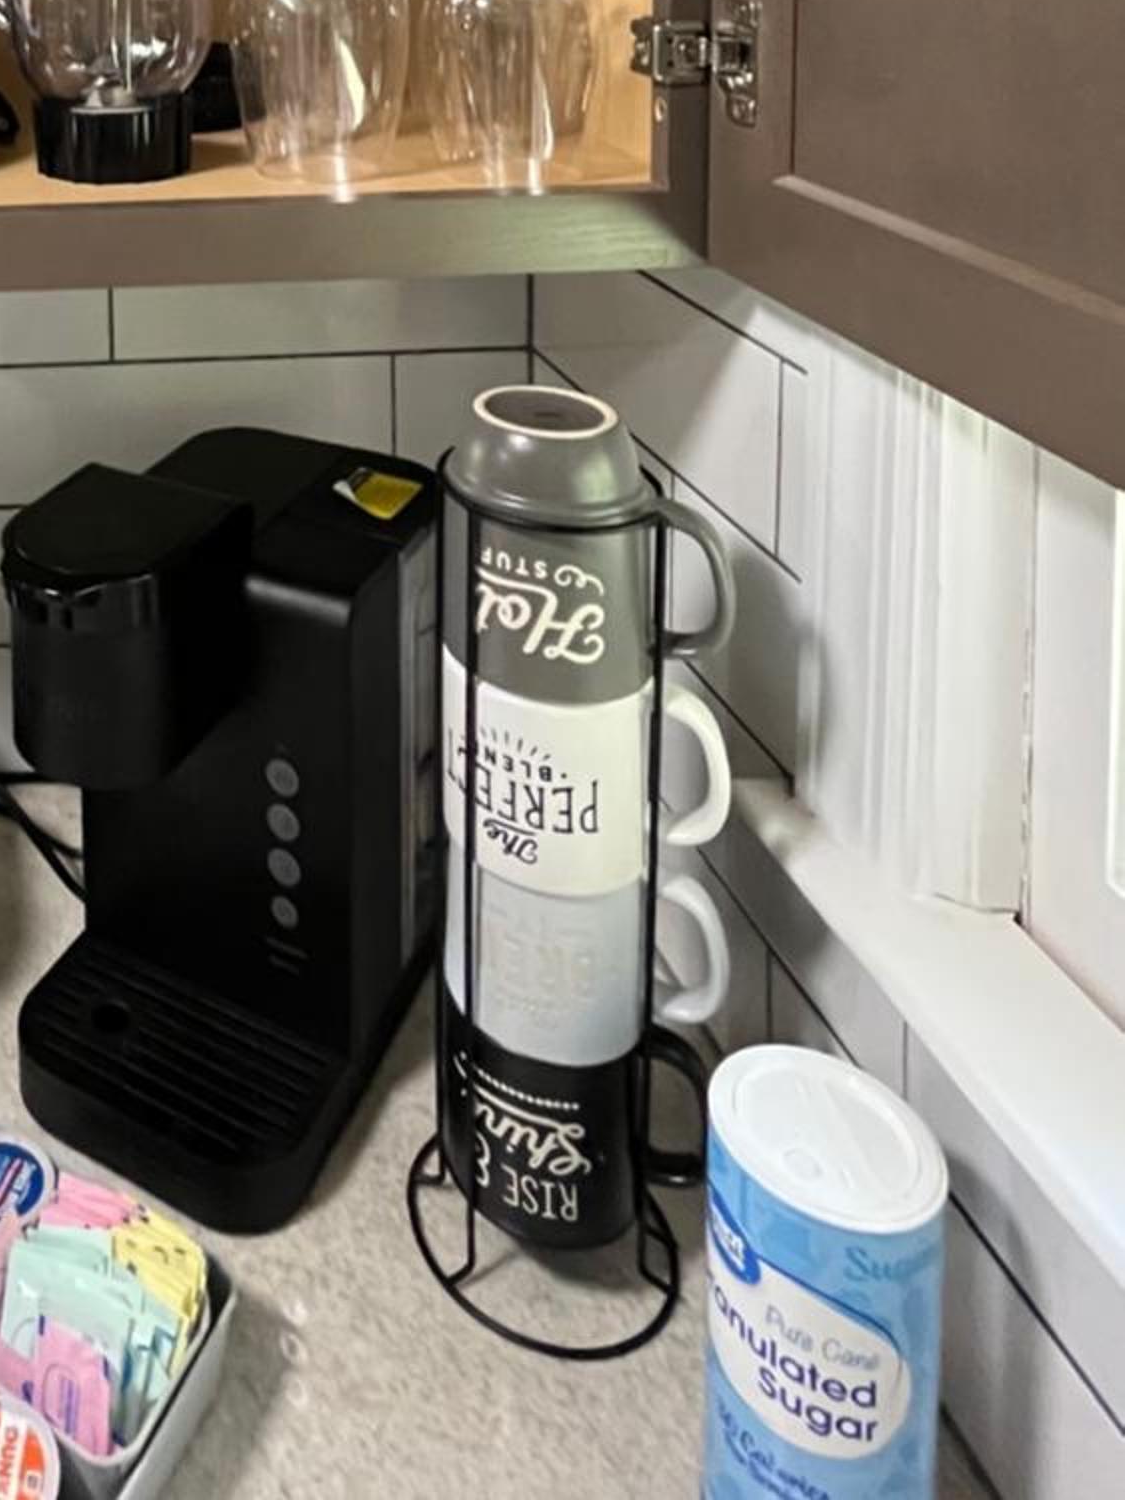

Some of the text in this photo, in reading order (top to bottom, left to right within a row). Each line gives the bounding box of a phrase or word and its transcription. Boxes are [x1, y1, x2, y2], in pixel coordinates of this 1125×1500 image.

[479, 546, 548, 580] STUF
[473, 742, 553, 783] BLEN
[482, 820, 539, 866] The
[474, 1090, 592, 1177] Shin
[500, 1163, 578, 1222] RISE
[759, 1366, 878, 1442] Sugar
